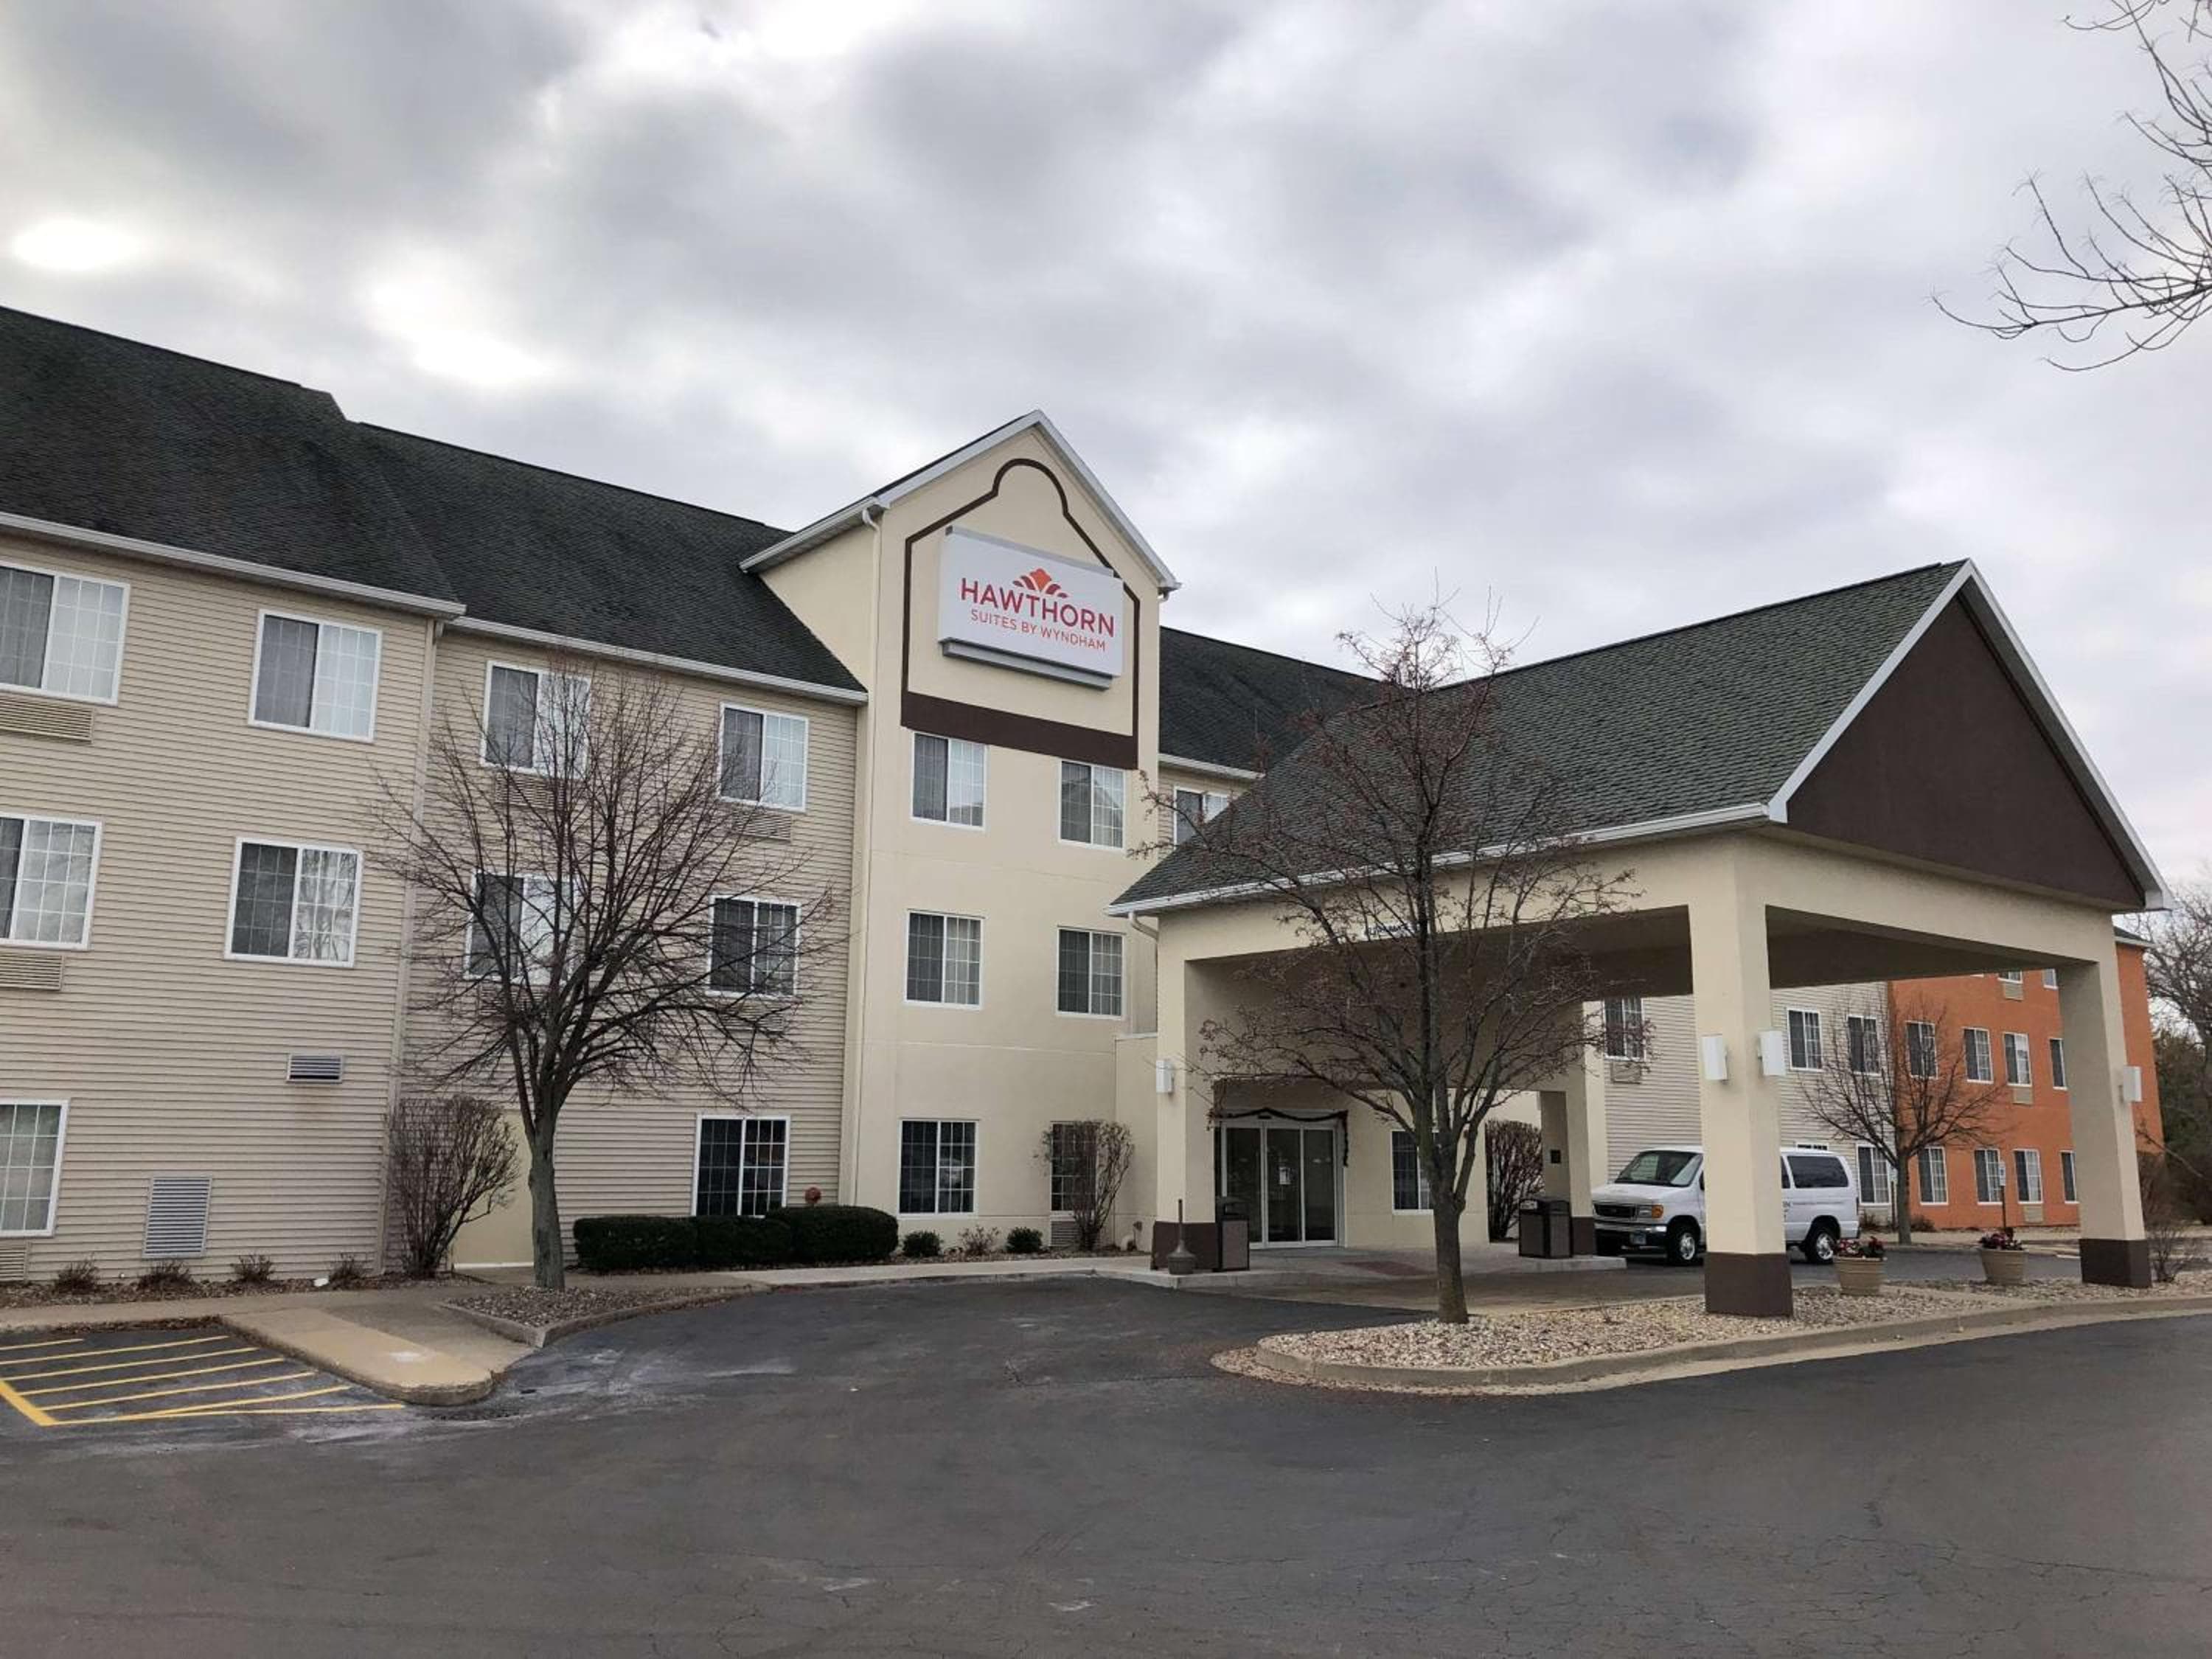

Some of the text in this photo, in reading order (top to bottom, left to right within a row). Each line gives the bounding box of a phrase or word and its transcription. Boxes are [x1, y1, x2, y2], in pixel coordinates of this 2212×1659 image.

[961, 578, 1114, 637] HAWTHORN
[971, 609, 1105, 652] SUITES BY WYNDHAM
